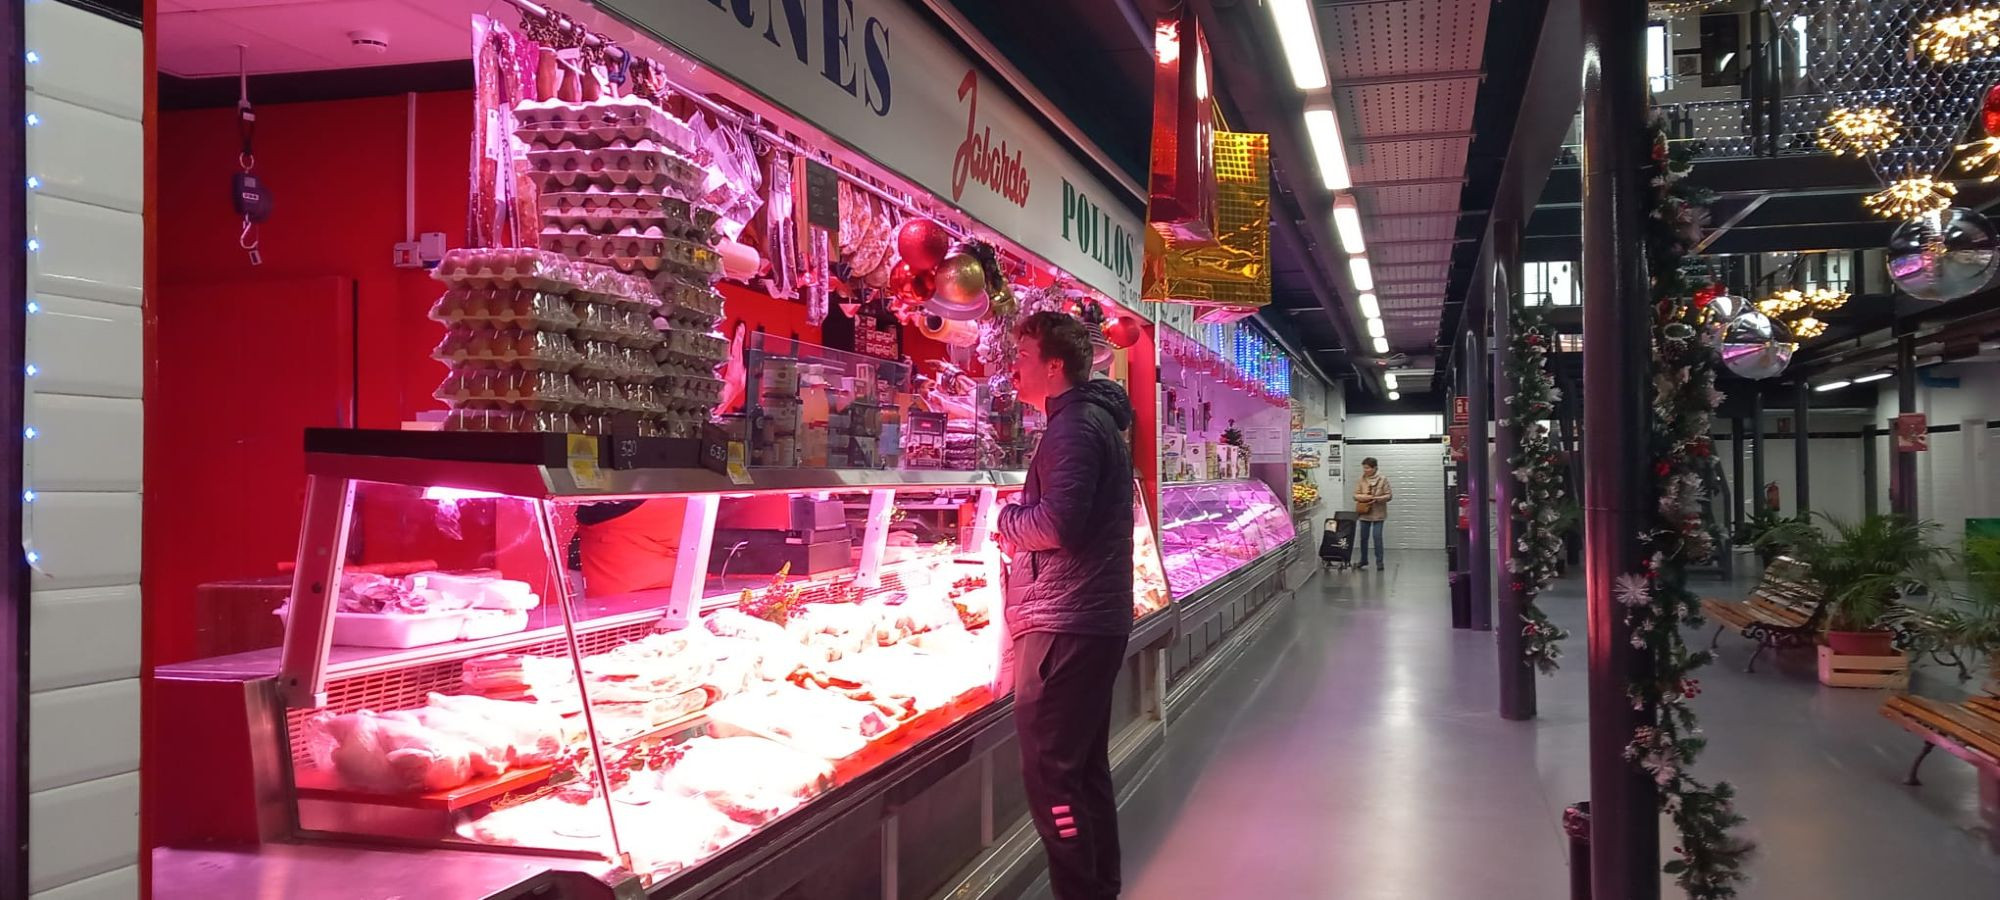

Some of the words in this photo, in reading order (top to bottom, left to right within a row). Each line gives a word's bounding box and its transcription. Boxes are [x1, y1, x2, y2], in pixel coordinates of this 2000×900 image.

[952, 69, 1030, 208] Jabardo
[1061, 176, 1134, 284] POLLOS
[710, 444, 727, 461] 630
